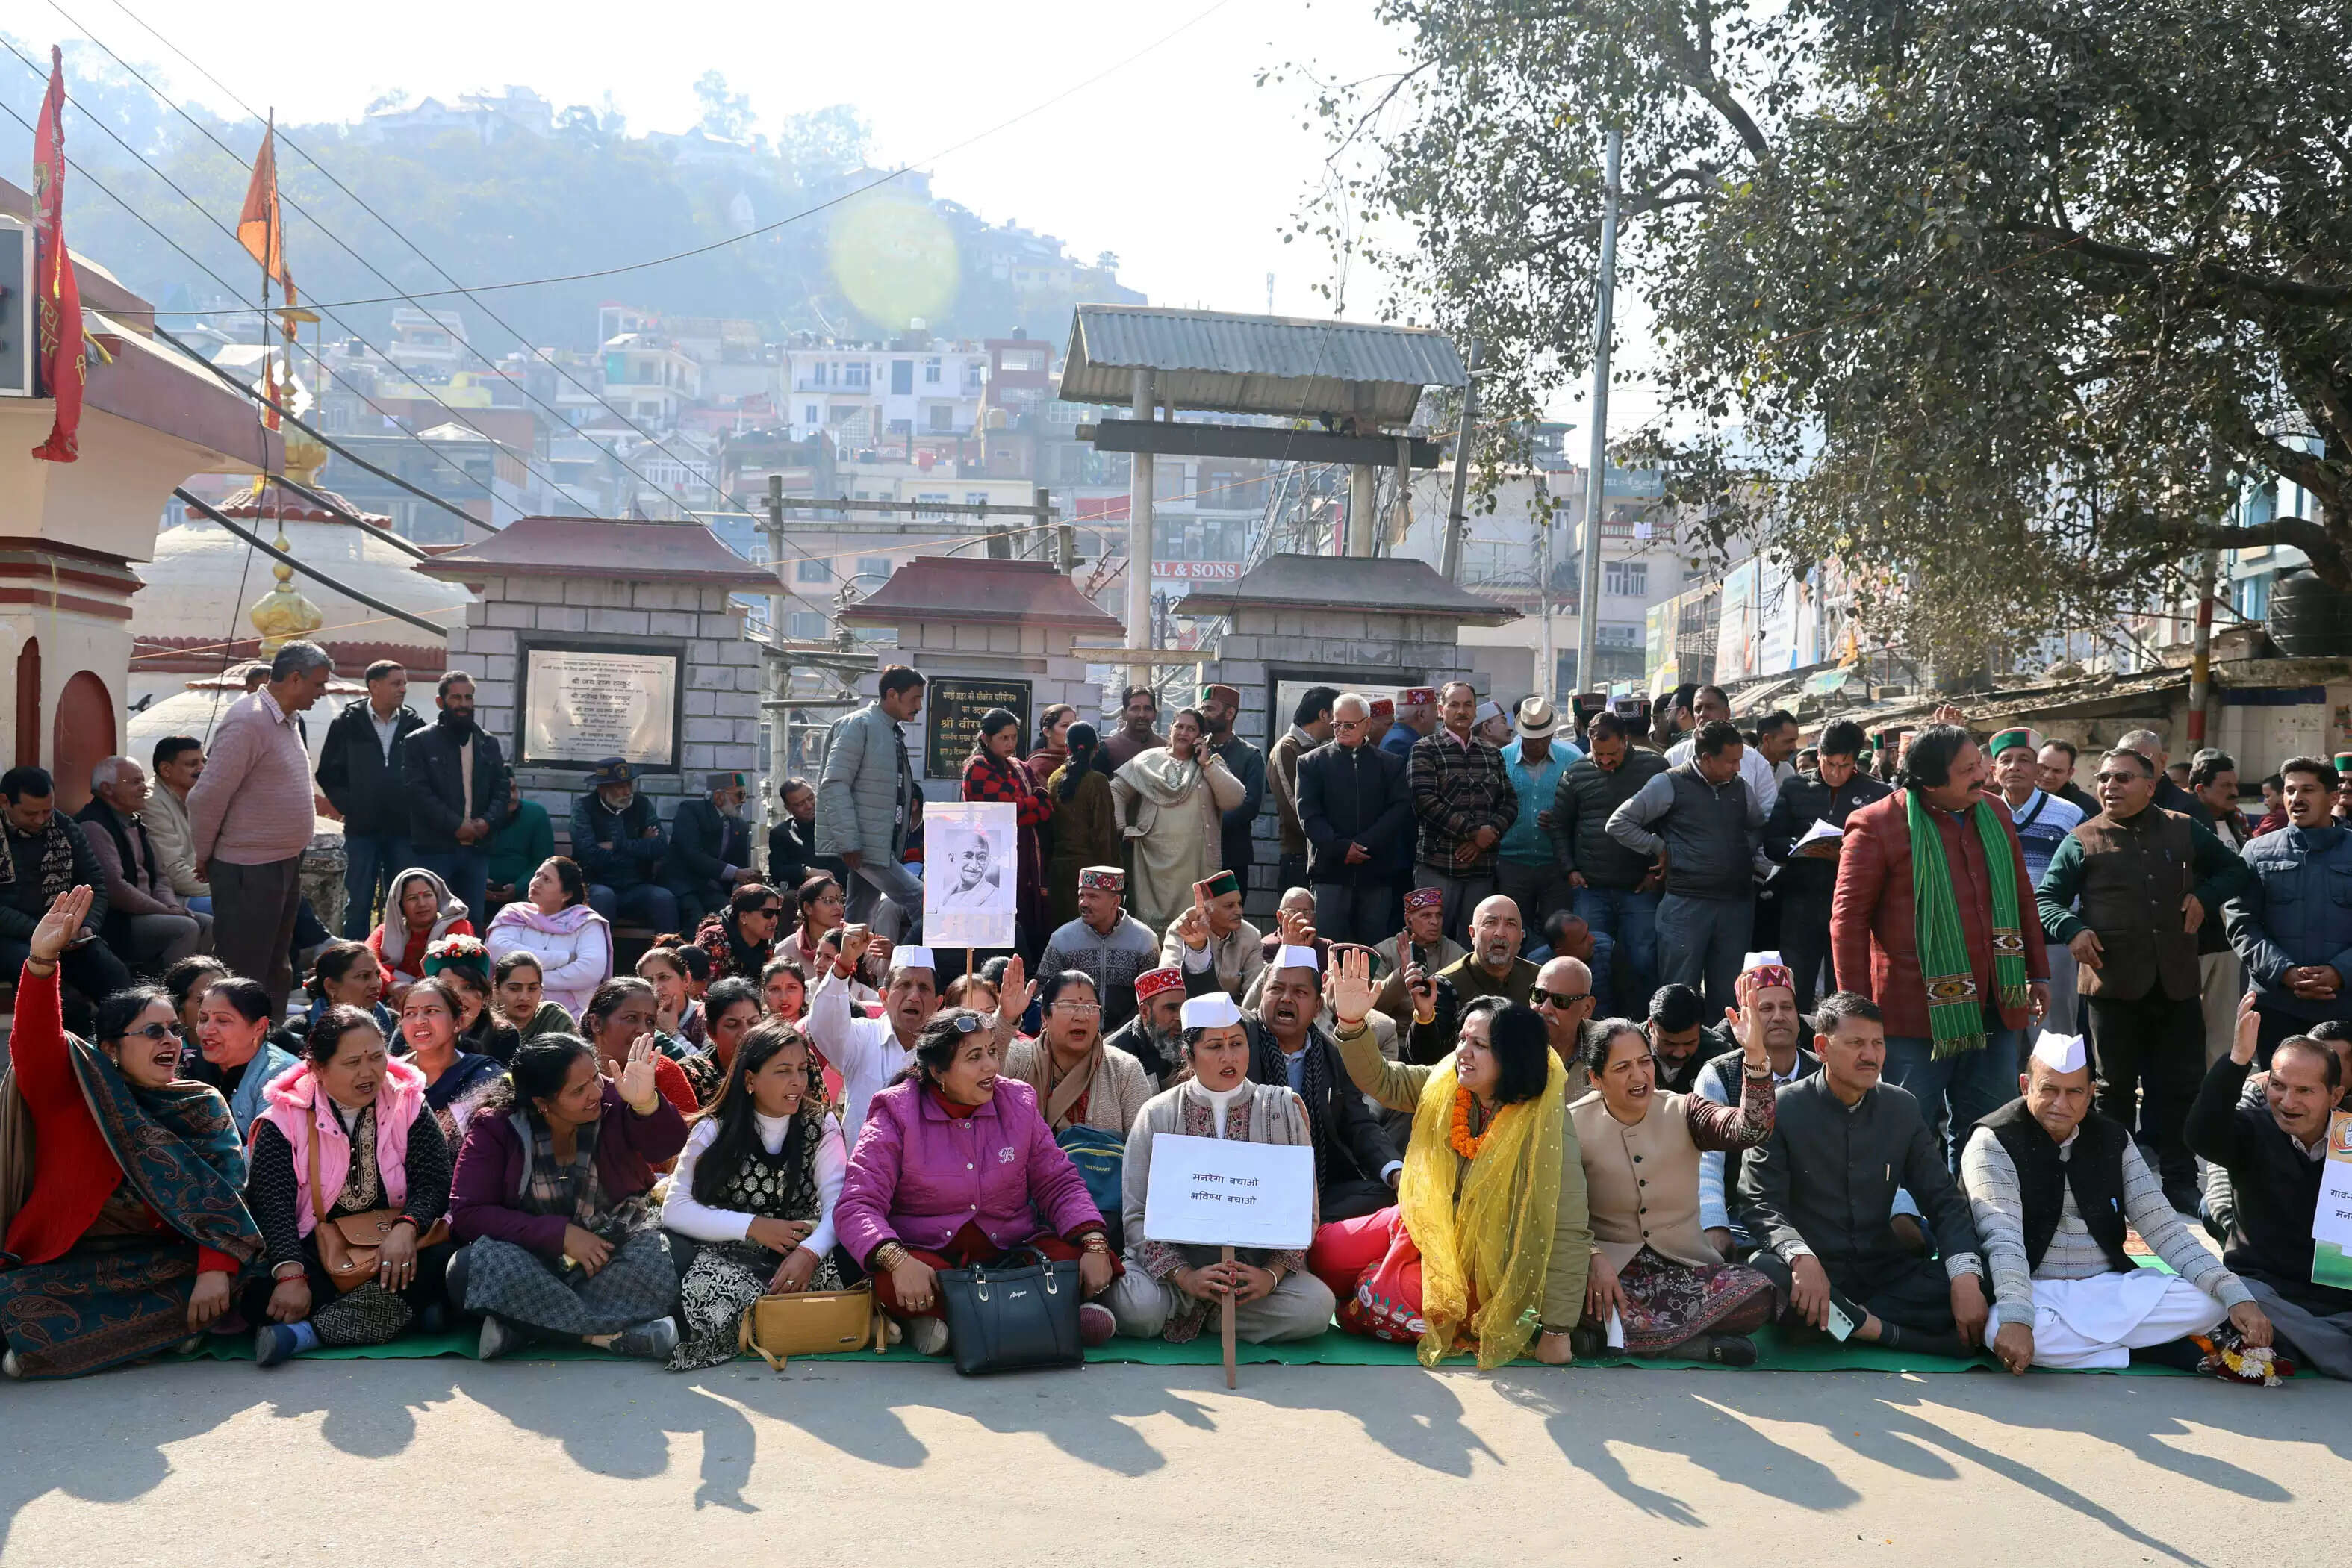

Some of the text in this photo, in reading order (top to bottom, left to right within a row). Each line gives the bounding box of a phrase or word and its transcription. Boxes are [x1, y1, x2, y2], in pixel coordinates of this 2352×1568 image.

[1174, 563, 1188, 577] &
[1192, 564, 1236, 578] SONS
[940, 717, 955, 729] श्री
[998, 1146, 1015, 1164] B
[1192, 1173, 1260, 1186] मनरेगा बचाओ
[1190, 1190, 1257, 1205] भविष्य बचाओ
[2330, 1188, 2352, 1200] गांव-
[2336, 1210, 2352, 1220] मन
